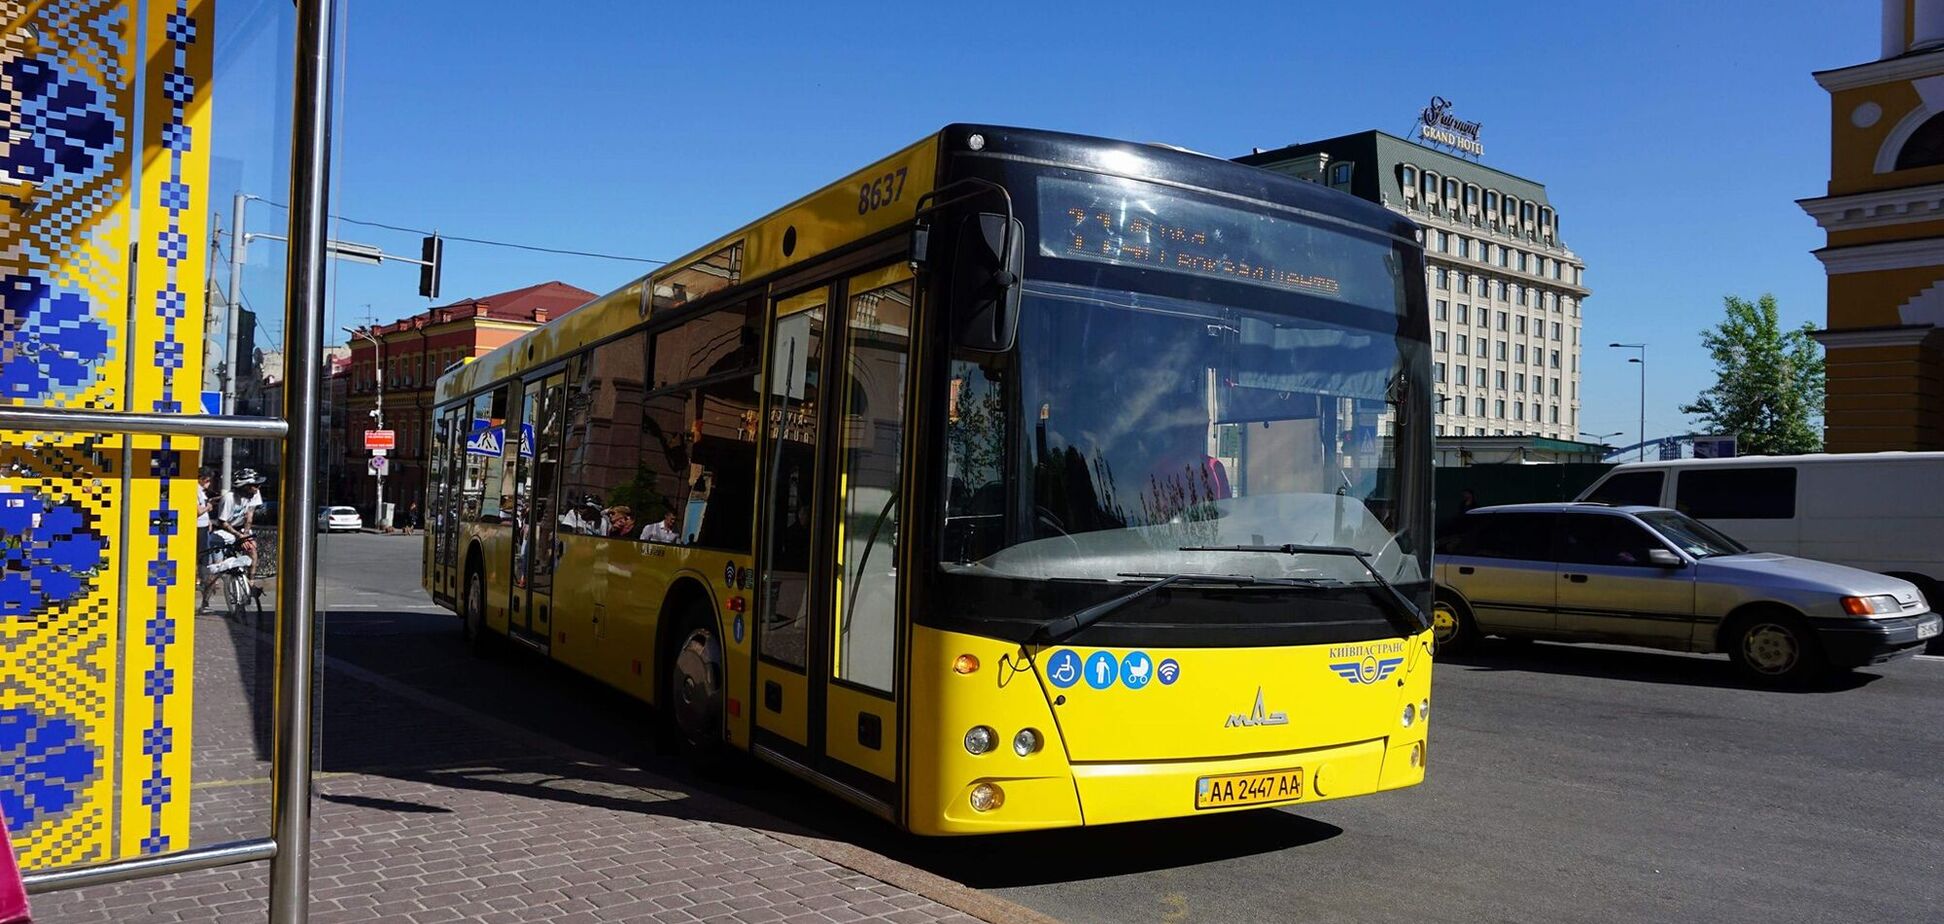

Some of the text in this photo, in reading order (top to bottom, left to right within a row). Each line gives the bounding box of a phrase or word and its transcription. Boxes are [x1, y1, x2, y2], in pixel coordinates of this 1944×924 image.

[1423, 125, 1485, 155] GRAND HOTEL
[858, 166, 908, 216] 8637
[1210, 774, 1300, 803] AA 2447 AA
